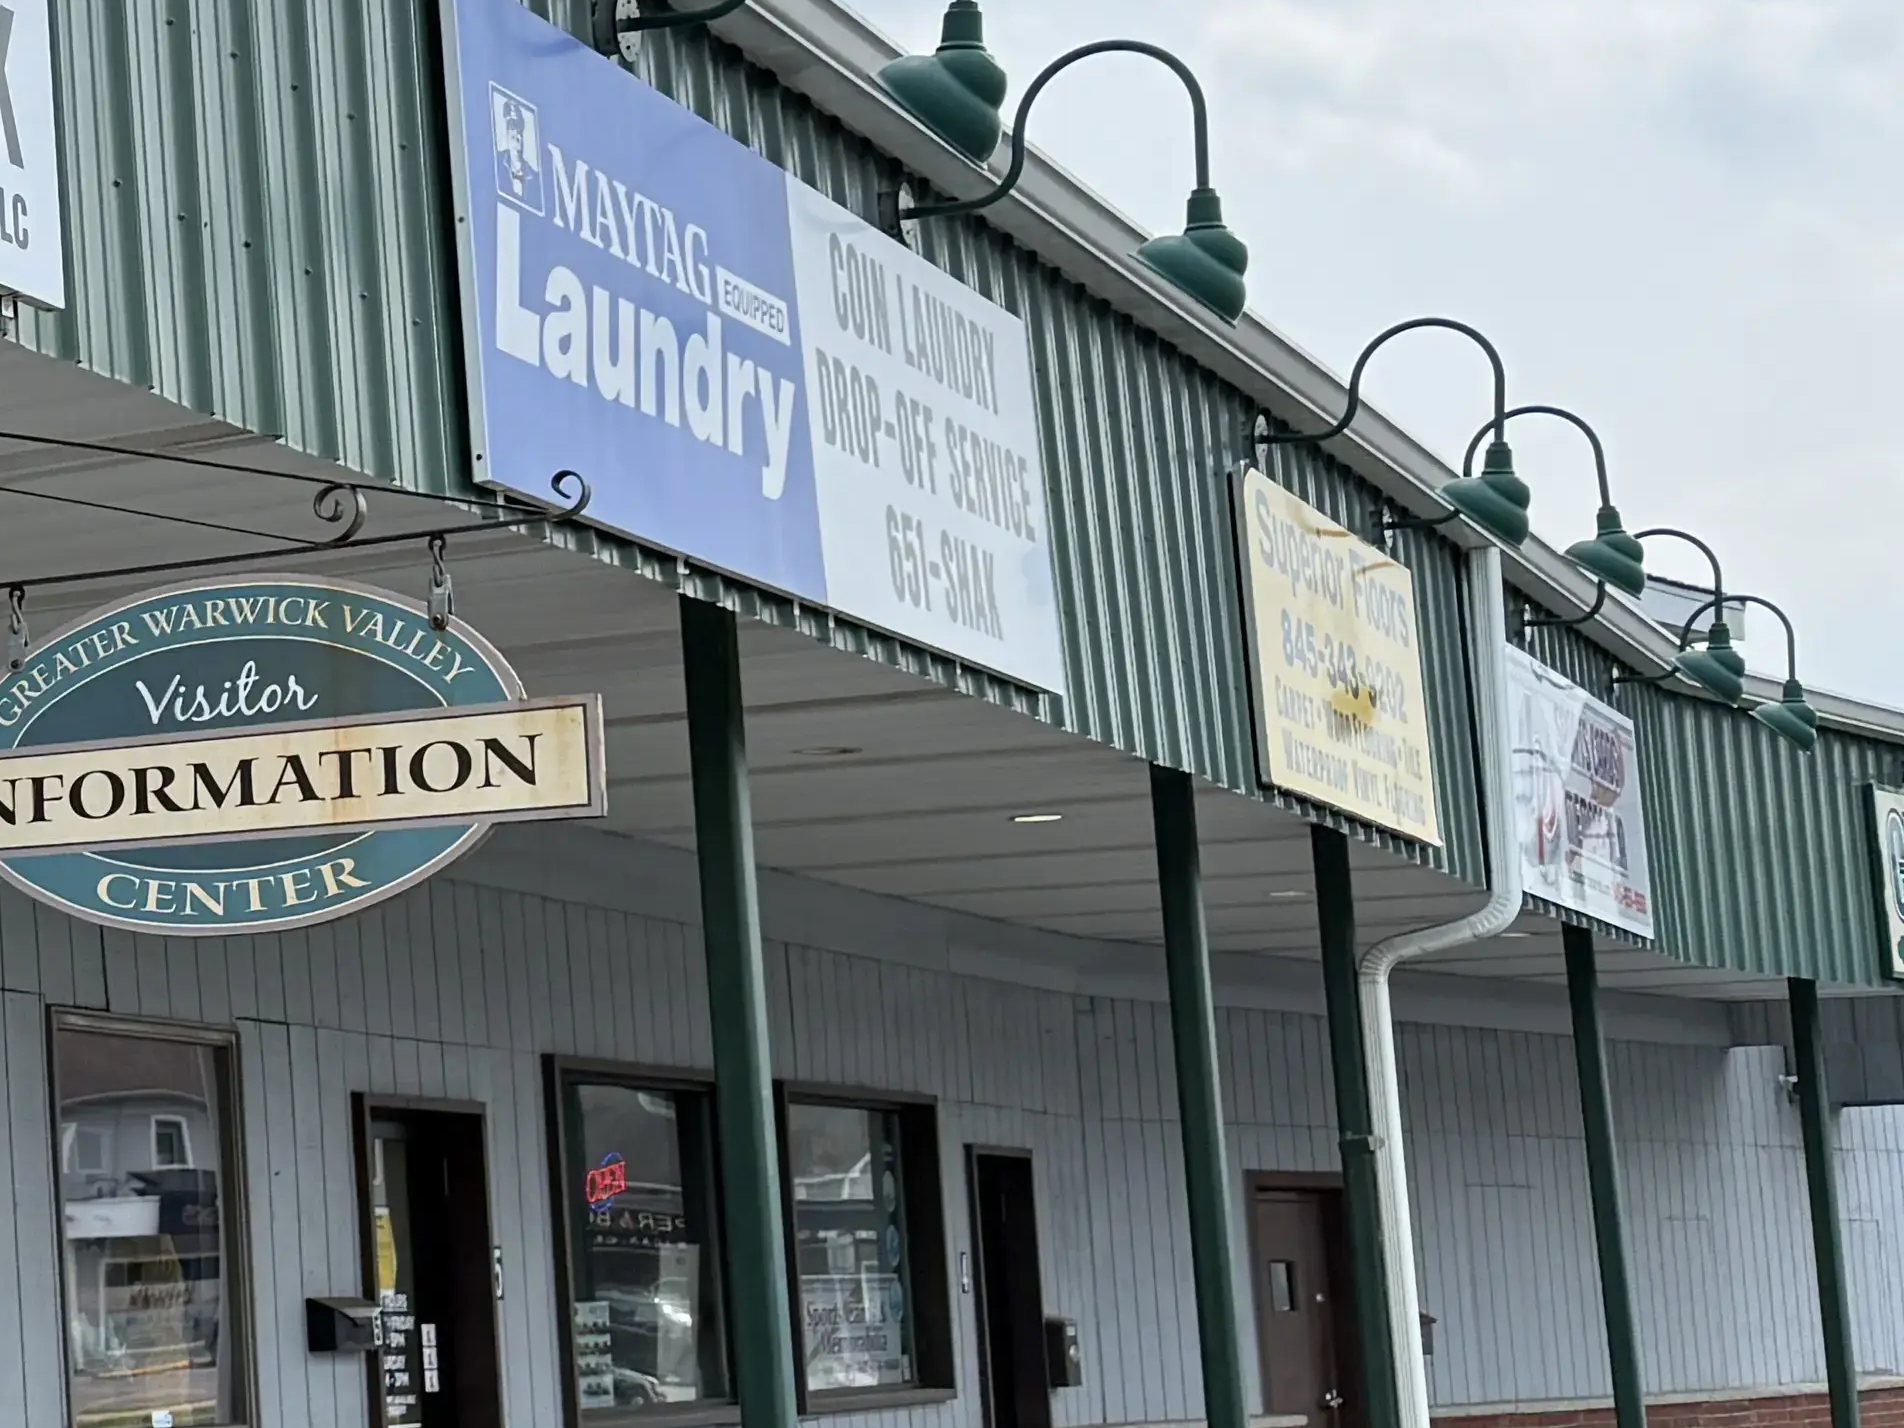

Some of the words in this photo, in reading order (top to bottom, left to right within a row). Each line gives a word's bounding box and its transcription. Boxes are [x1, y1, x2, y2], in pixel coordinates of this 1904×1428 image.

[548, 142, 711, 304] MAYTAG
[496, 201, 795, 500] Laundry
[723, 279, 785, 334] EQUIPPED
[829, 232, 892, 356] COIN
[897, 273, 999, 416] LAUNDRY
[816, 347, 937, 495] DROP-OFF
[944, 416, 1036, 543] SERVICE
[139, 595, 329, 638] WARWICK
[342, 605, 476, 685] VALLEY
[886, 504, 1003, 641] 651-SHAK
[1255, 488, 1344, 610] Superior
[1349, 547, 1410, 648] Floors
[136, 660, 319, 724] Visitor
[96, 856, 371, 915] CENTER
